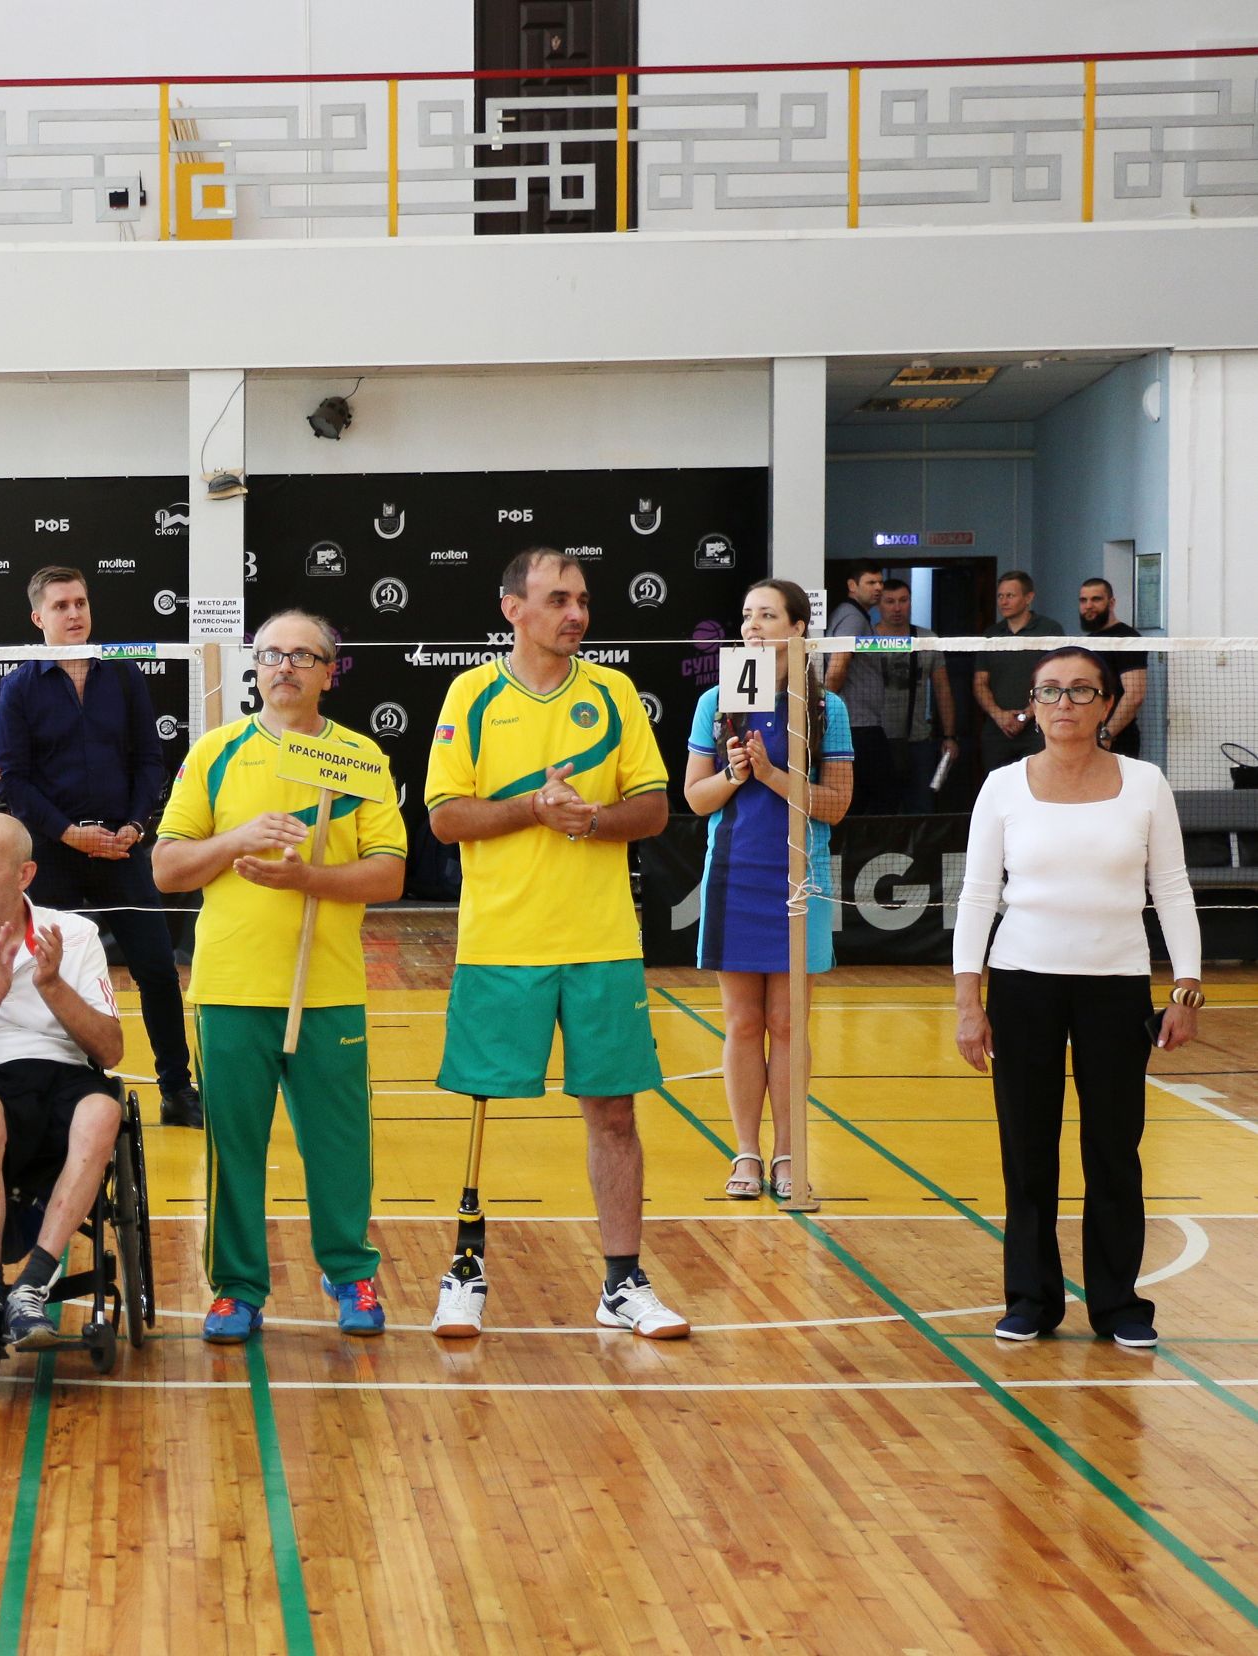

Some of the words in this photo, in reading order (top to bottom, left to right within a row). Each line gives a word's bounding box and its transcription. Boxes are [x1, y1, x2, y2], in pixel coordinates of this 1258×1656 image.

[497, 510, 534, 523] РФБ
[34, 518, 70, 533] РФБ
[154, 527, 180, 536] СКФУ
[430, 549, 468, 560] molten
[564, 545, 603, 556] molten
[98, 558, 136, 568] molten
[875, 638, 909, 650] YONEX
[121, 645, 154, 656] YONEX
[736, 659, 758, 705] 4
[288, 743, 382, 775] КРАСНОДАРСКИЙ
[319, 767, 348, 783] КРАЙ
